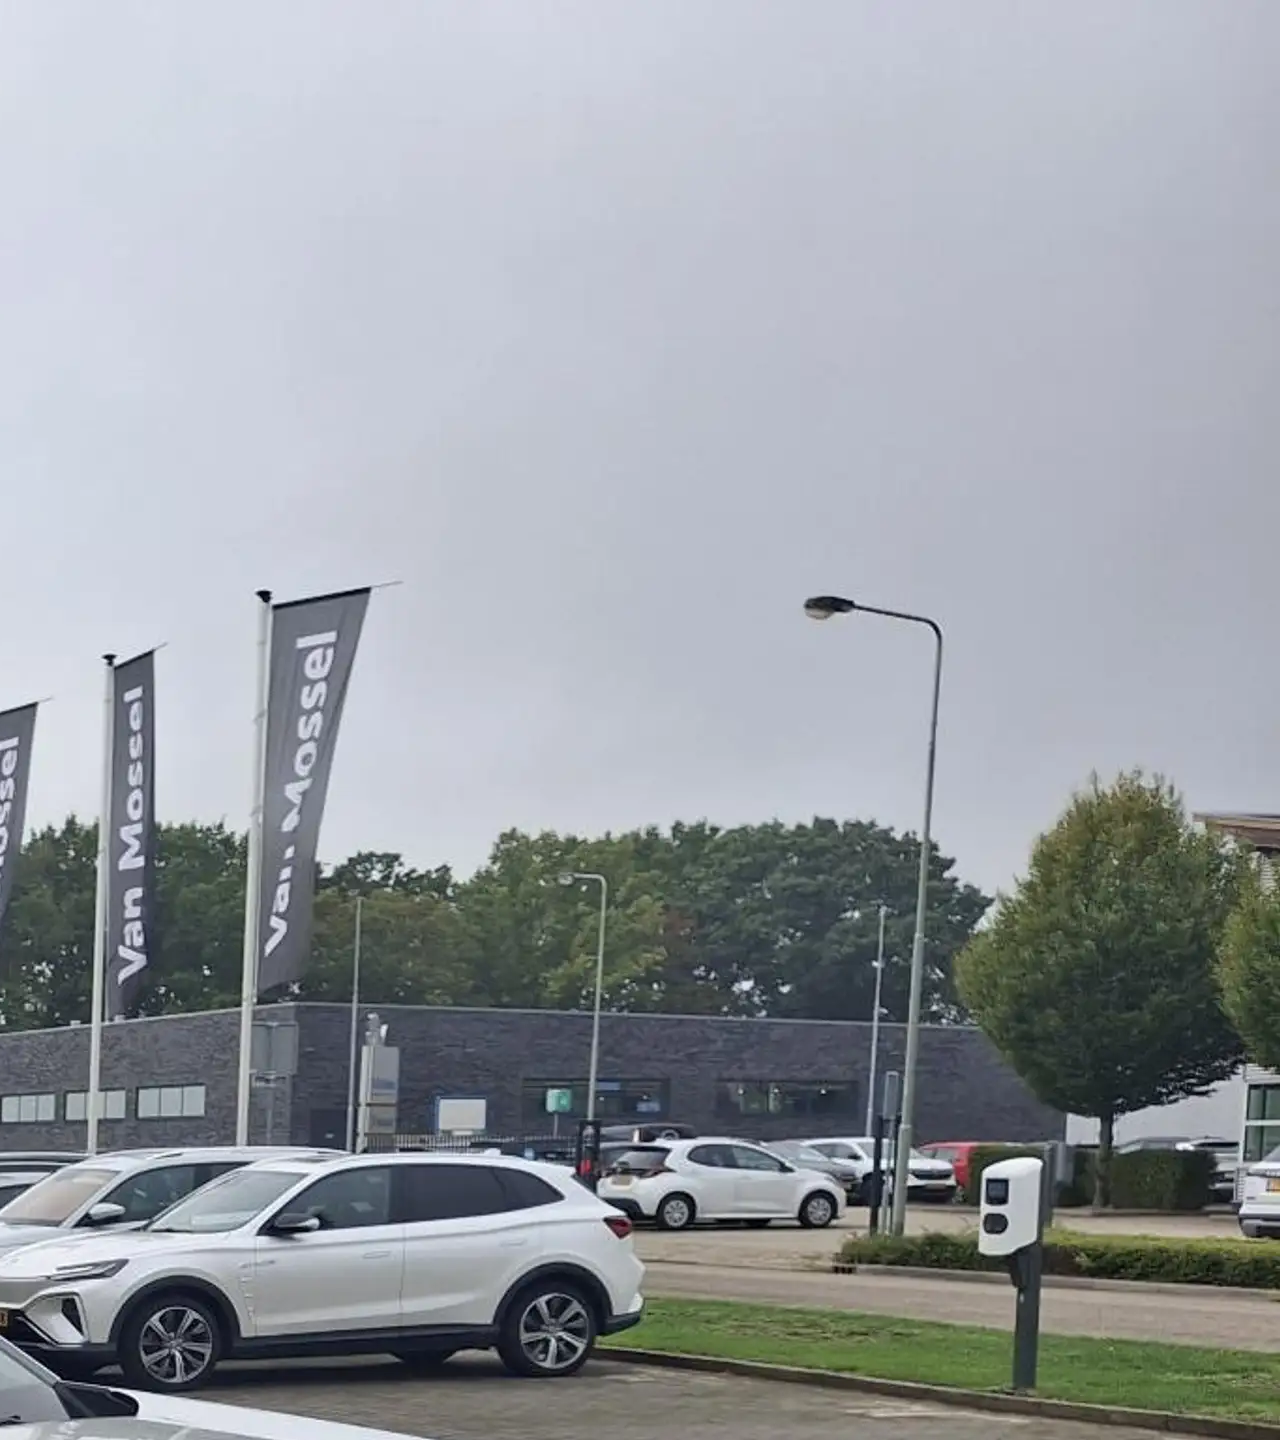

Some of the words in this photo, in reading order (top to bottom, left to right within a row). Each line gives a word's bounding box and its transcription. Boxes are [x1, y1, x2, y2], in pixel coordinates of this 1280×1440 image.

[118, 685, 146, 871] Mossel
[280, 630, 338, 832] Mossel
[118, 887, 148, 985] Van
